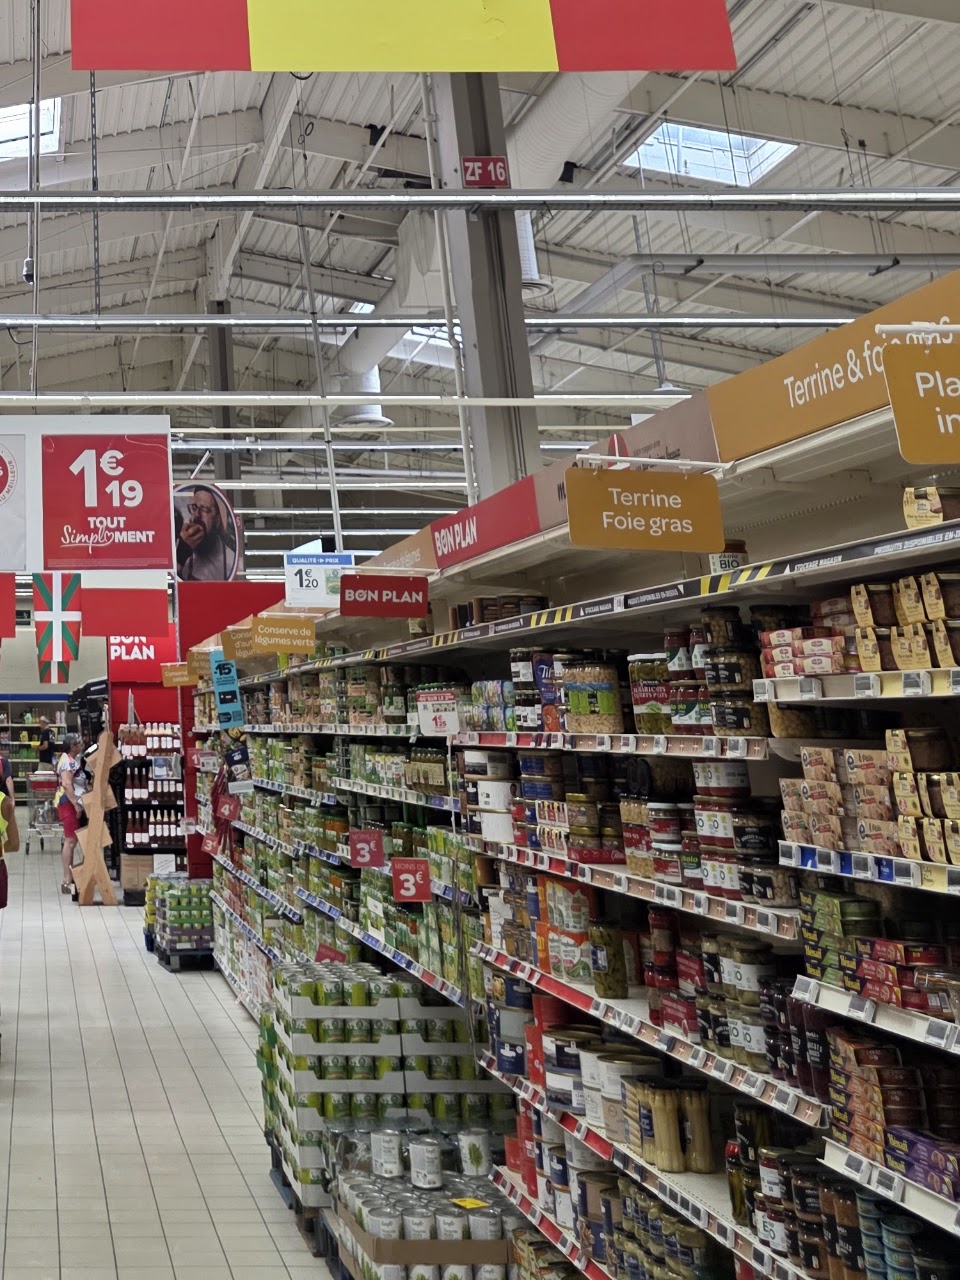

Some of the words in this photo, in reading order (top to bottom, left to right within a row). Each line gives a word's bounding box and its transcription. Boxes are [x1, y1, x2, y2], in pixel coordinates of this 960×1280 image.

[465, 161, 485, 182] ZF
[488, 161, 505, 181] 16
[784, 363, 845, 408] Terrine
[846, 349, 864, 384] &
[6, 459, 16, 496] MEILLEUR
[608, 488, 682, 508] Terrine
[88, 516, 127, 529] TOUT
[602, 511, 646, 531] Foie
[649, 516, 693, 536] gras
[434, 525, 455, 557] BON
[455, 516, 478, 550] PLAN
[903, 534, 944, 549] DISPONIBLES
[719, 559, 740, 569] BIO
[794, 558, 819, 572] STOCKAGE
[819, 556, 843, 568] MAGASIN
[344, 589, 379, 602] BON
[382, 590, 423, 603] PLAN
[258, 624, 298, 636] Conserve
[300, 626, 312, 637] de
[255, 635, 291, 648] légumes
[292, 637, 315, 648] verts
[110, 645, 155, 660] PLAN
[394, 862, 417, 871] MOINS
[399, 870, 424, 897] 3€
